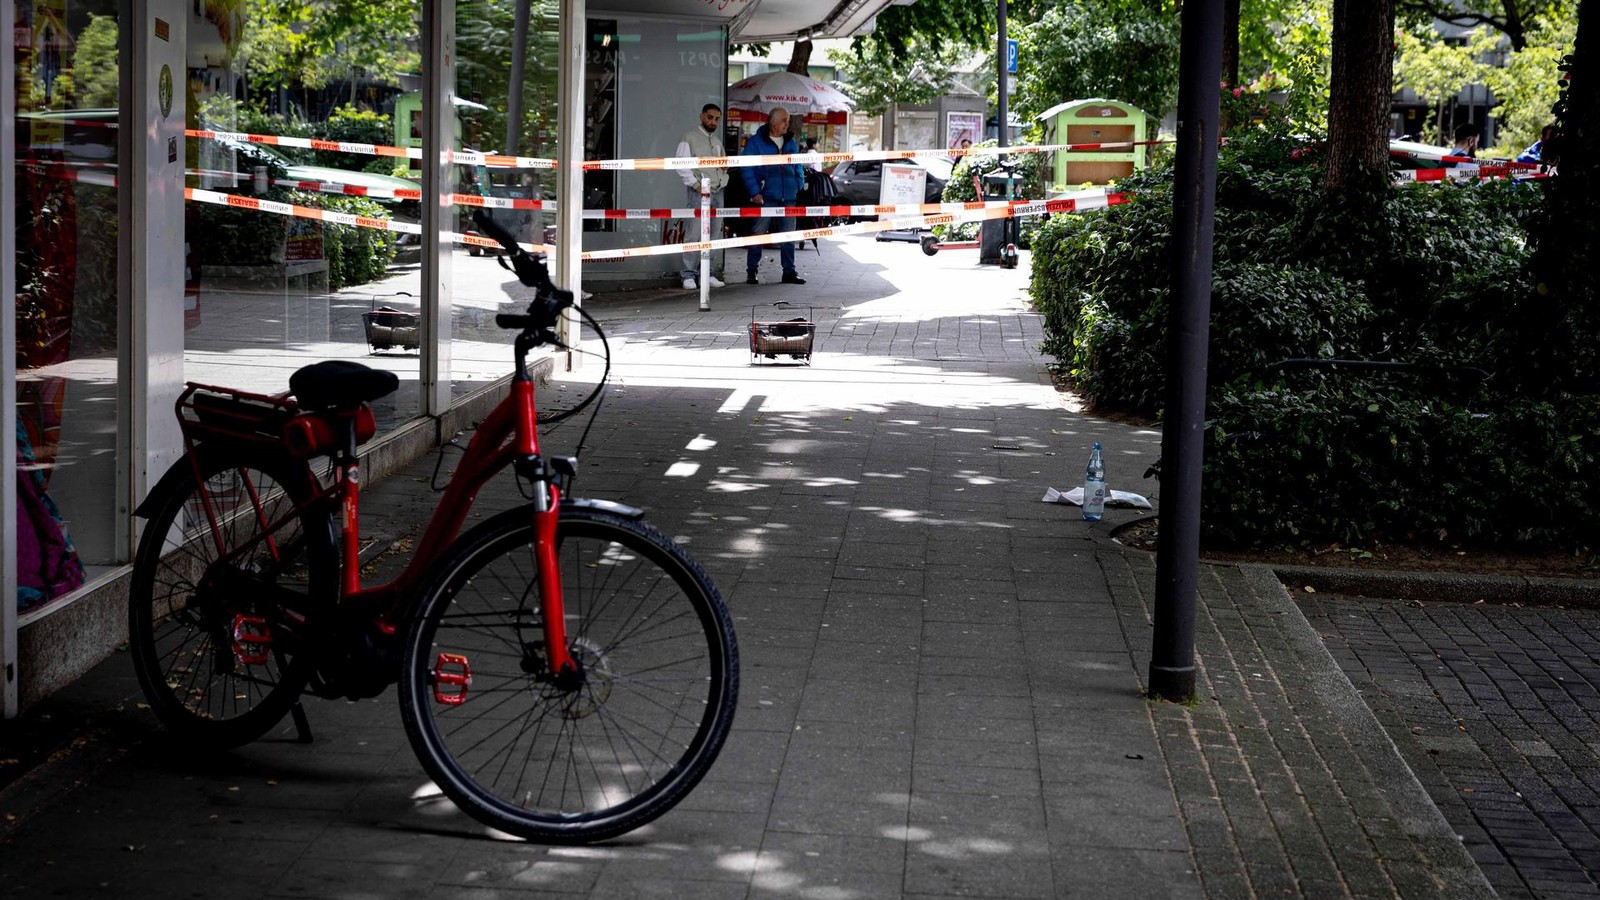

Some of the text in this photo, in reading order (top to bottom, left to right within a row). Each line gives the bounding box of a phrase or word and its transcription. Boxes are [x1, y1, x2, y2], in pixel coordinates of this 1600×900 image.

[765, 93, 809, 103] www.kik.de
[1007, 201, 1073, 215] POLIZEIABSPERRUNG
[662, 219, 686, 245] kik
